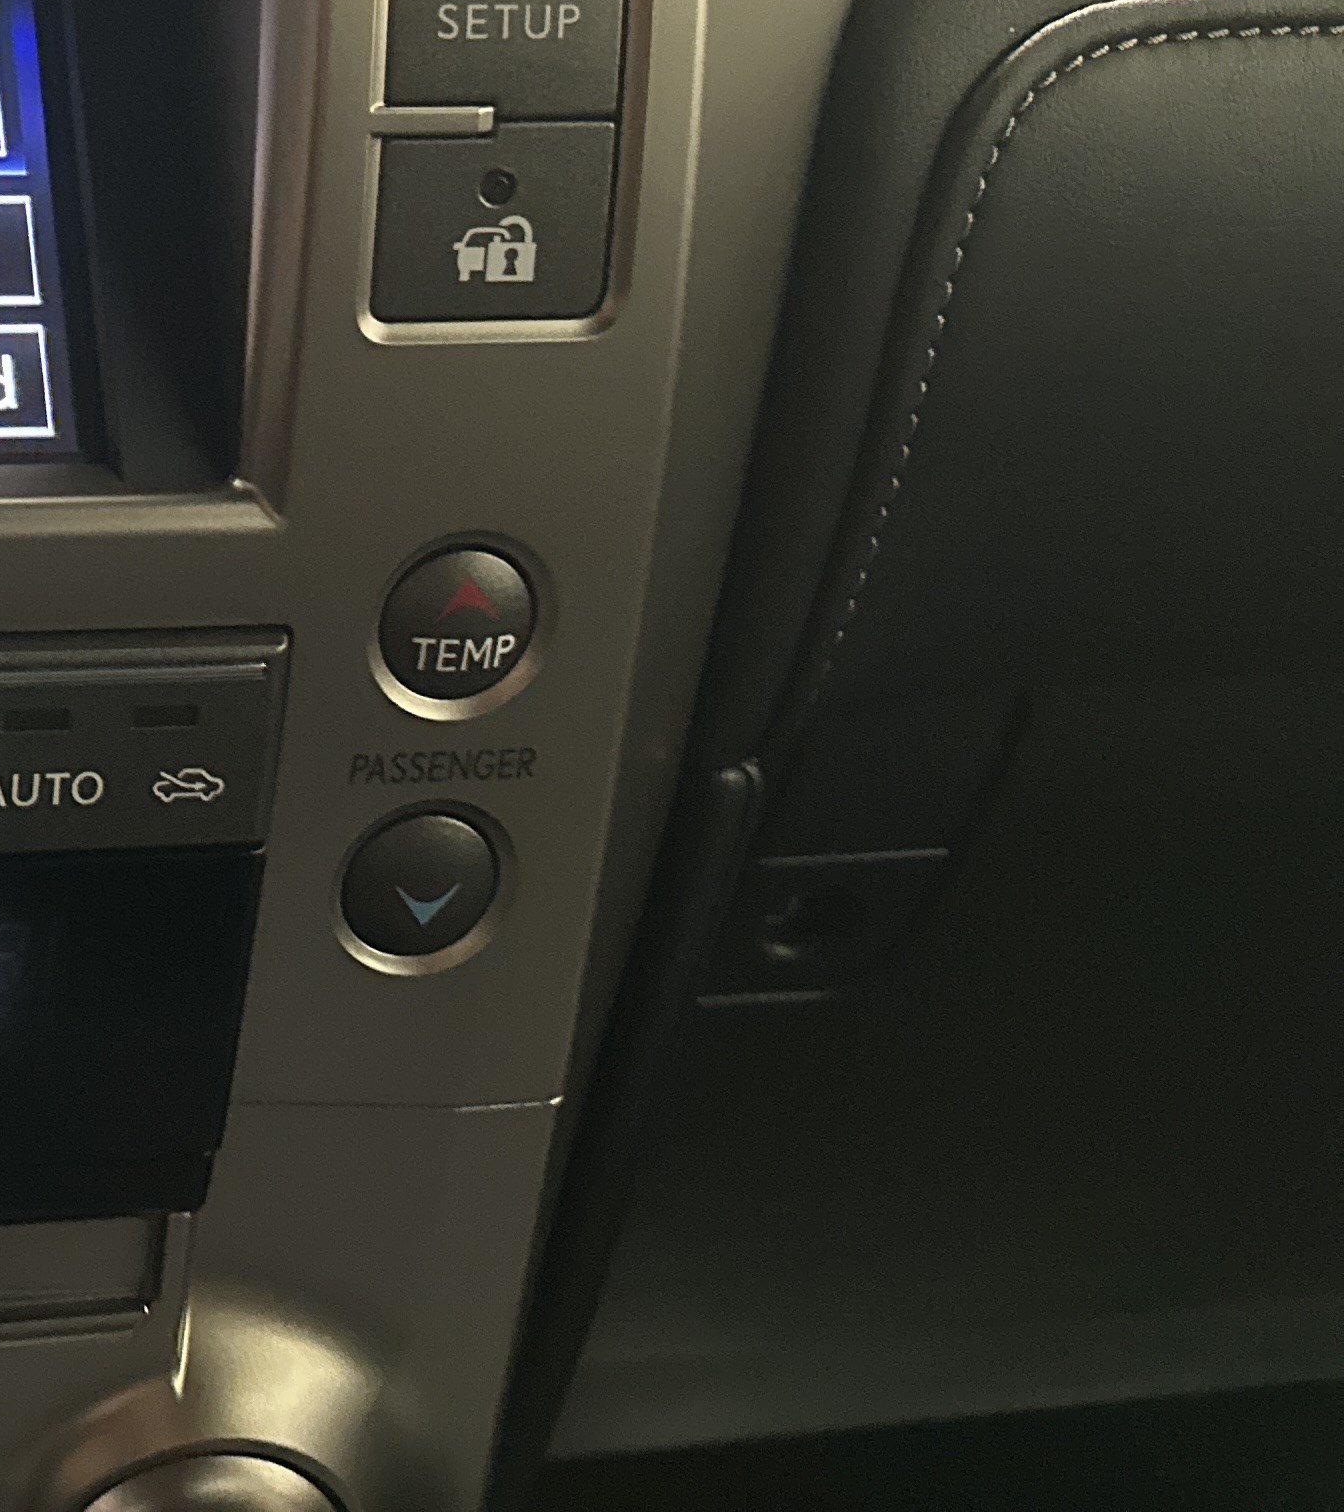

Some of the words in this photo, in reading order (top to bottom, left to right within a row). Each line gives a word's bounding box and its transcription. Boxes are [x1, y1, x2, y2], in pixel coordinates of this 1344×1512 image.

[437, 5, 581, 39] SETUP
[412, 634, 516, 673] TEMP
[348, 748, 538, 785] PASSENGER
